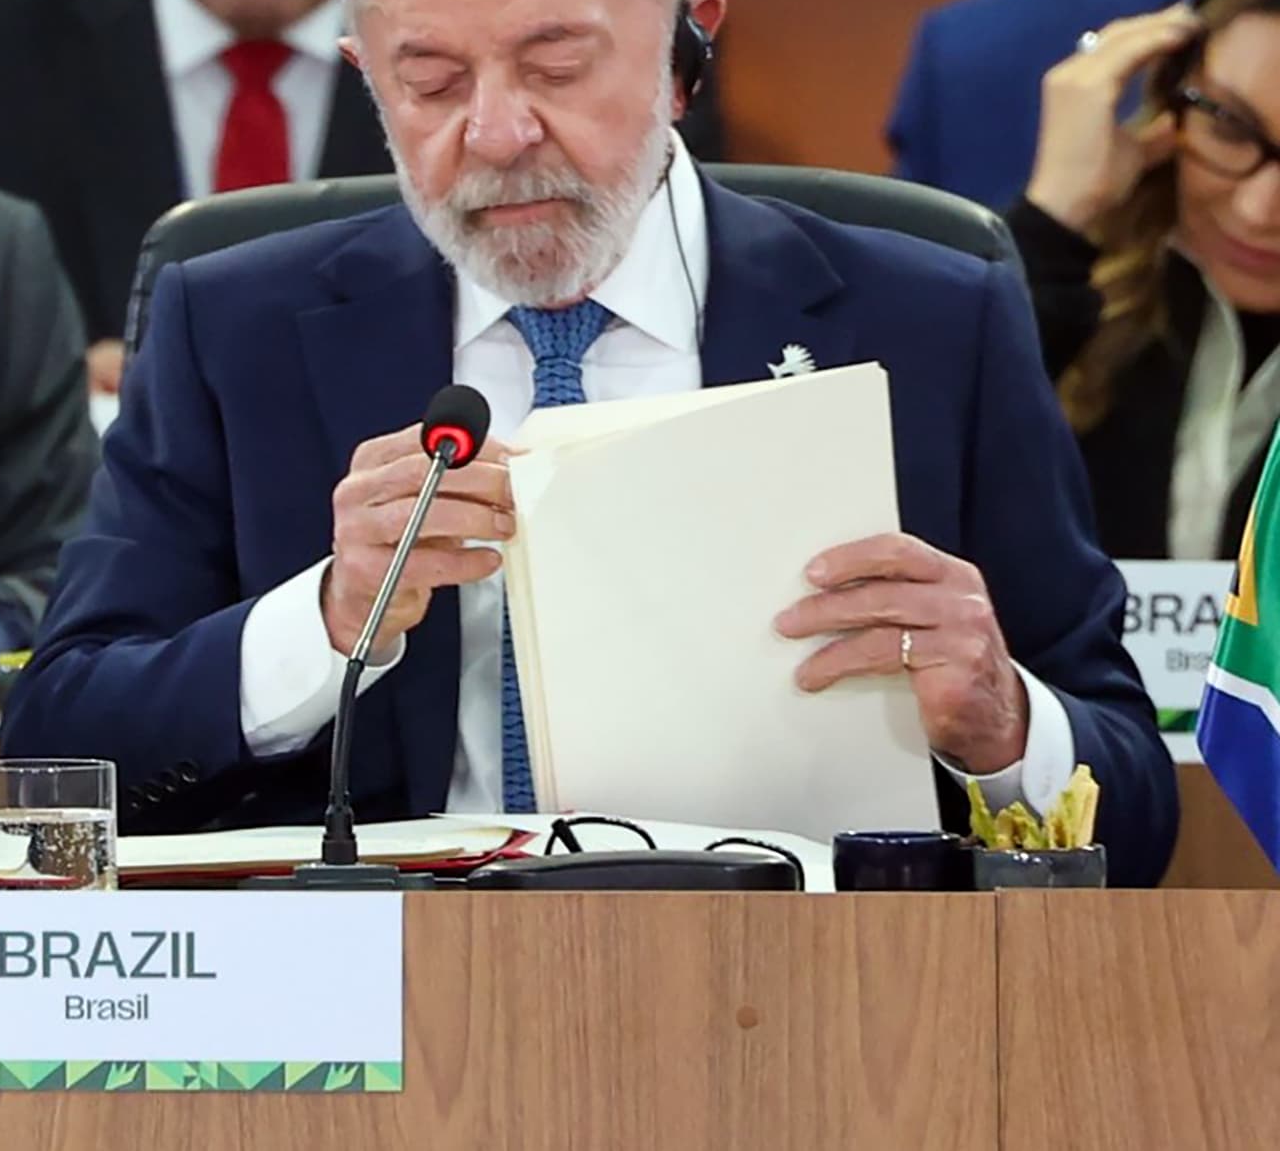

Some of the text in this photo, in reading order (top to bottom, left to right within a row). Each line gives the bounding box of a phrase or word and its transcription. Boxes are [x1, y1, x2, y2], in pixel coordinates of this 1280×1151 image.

[1123, 593, 1221, 634] BRA
[1165, 649, 1212, 673] Bra
[64, 993, 149, 1021] Brasil
